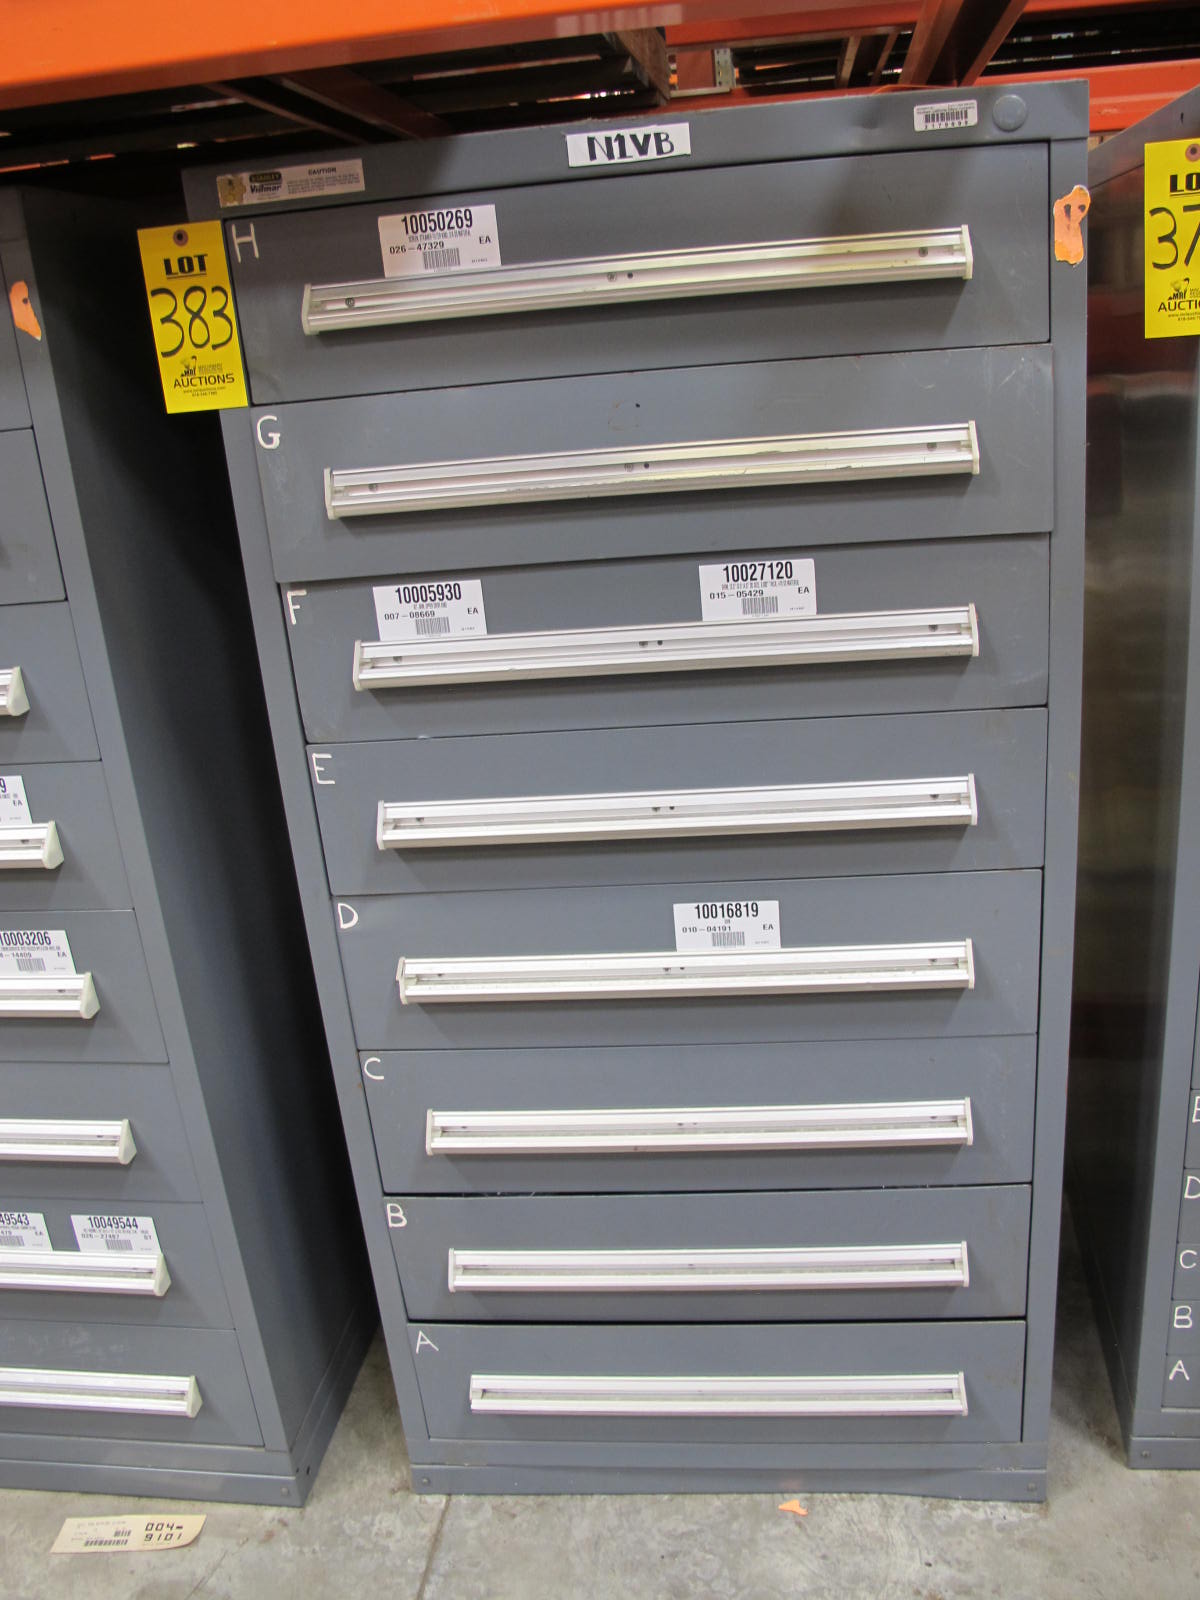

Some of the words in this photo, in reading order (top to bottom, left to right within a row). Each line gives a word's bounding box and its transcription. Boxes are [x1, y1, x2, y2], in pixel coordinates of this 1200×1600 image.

[587, 132, 675, 161] N1VB
[401, 208, 473, 235] 10050269
[232, 223, 260, 263] H
[479, 235, 491, 244] EA
[163, 254, 208, 276] LOT
[1158, 299, 1200, 312] AUCTI
[150, 285, 234, 358] 383
[173, 373, 235, 389] AUCTIONS
[257, 416, 281, 449] G
[723, 561, 793, 583] 10027120
[395, 582, 462, 604] 10005930
[797, 586, 810, 594] EA
[287, 589, 307, 625] F
[467, 607, 479, 615] EA
[312, 753, 335, 785] E
[338, 903, 359, 929] D
[695, 902, 759, 919] 10016819
[762, 923, 774, 931] EA
[364, 1057, 384, 1081] C
[88, 1216, 139, 1229] 10049544
[386, 1203, 408, 1228] B
[1179, 1250, 1197, 1269] C
[1173, 1305, 1192, 1329] B
[415, 1330, 440, 1354] A
[1168, 1360, 1190, 1381] A
